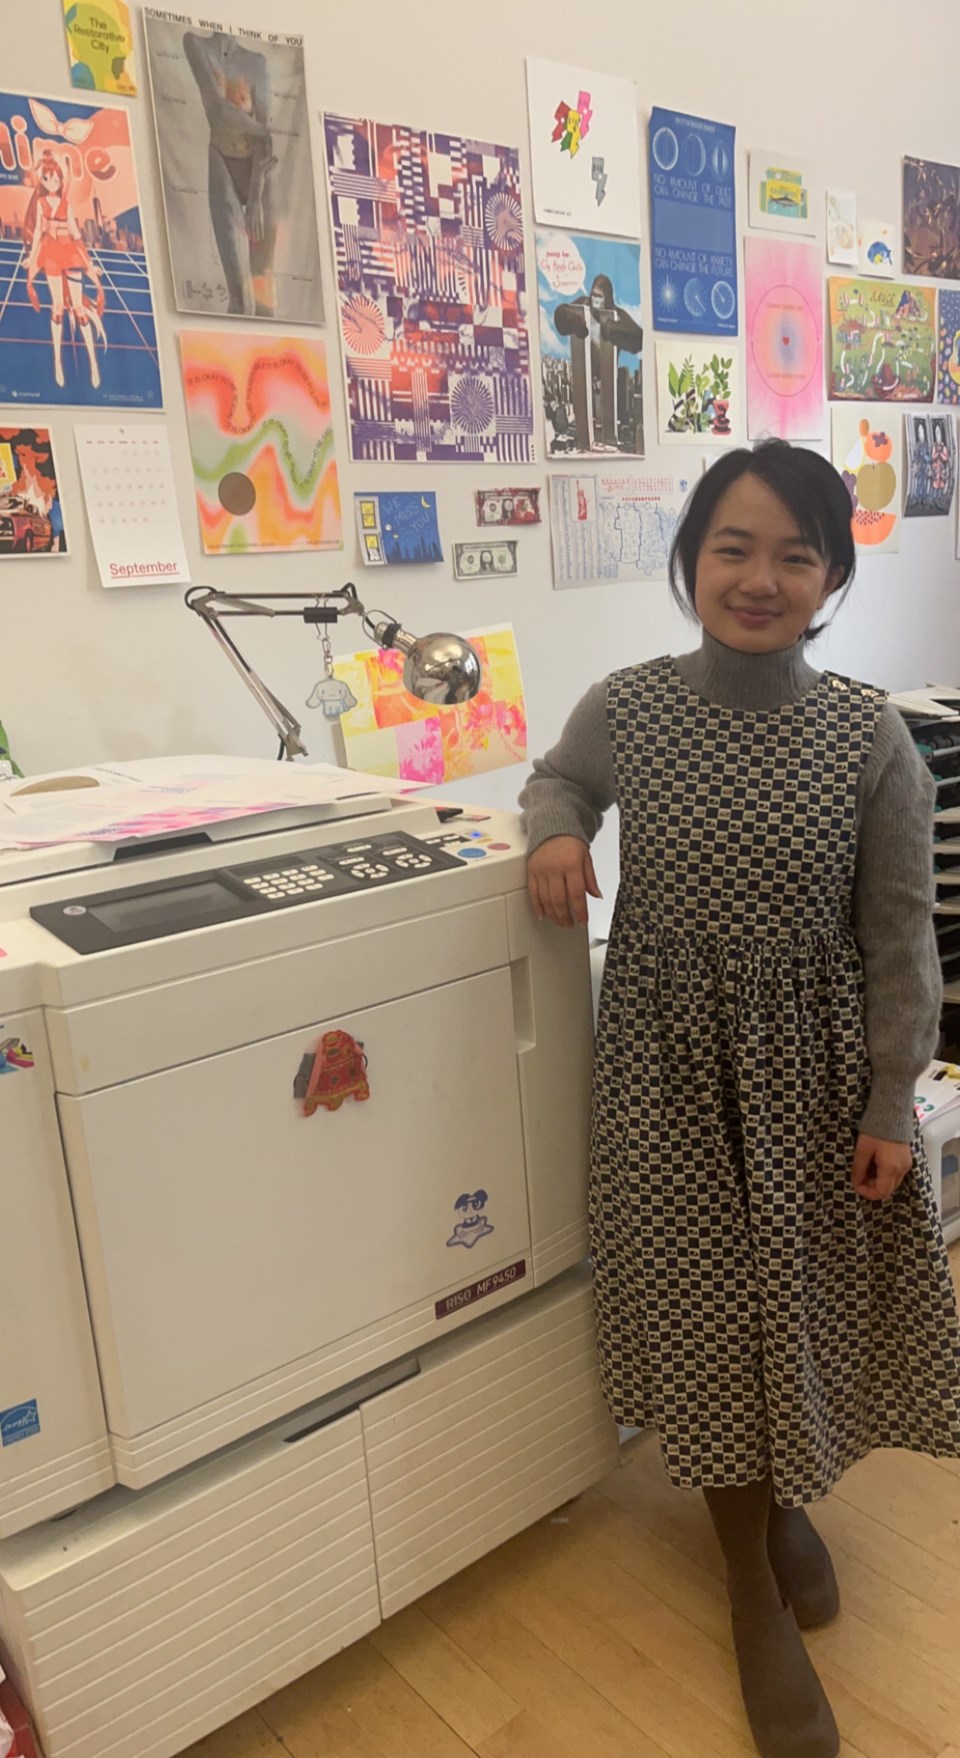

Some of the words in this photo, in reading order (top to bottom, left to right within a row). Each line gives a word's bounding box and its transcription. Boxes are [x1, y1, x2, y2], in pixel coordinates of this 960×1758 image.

[90, 17, 107, 30] The
[145, 7, 192, 25] SOMETIMES
[199, 20, 223, 31] WHEN
[238, 28, 262, 39] THINK
[268, 34, 279, 42] OF
[285, 36, 303, 46] YOU
[73, 24, 126, 42] Restorative
[90, 40, 109, 54] City
[654, 172, 665, 185] NO
[382, 495, 401, 514] WE
[394, 500, 419, 526] MISS
[410, 512, 430, 532] YOU
[110, 561, 178, 578] September
[446, 1290, 471, 1310] RISO
[477, 1266, 517, 1295] MF9450
